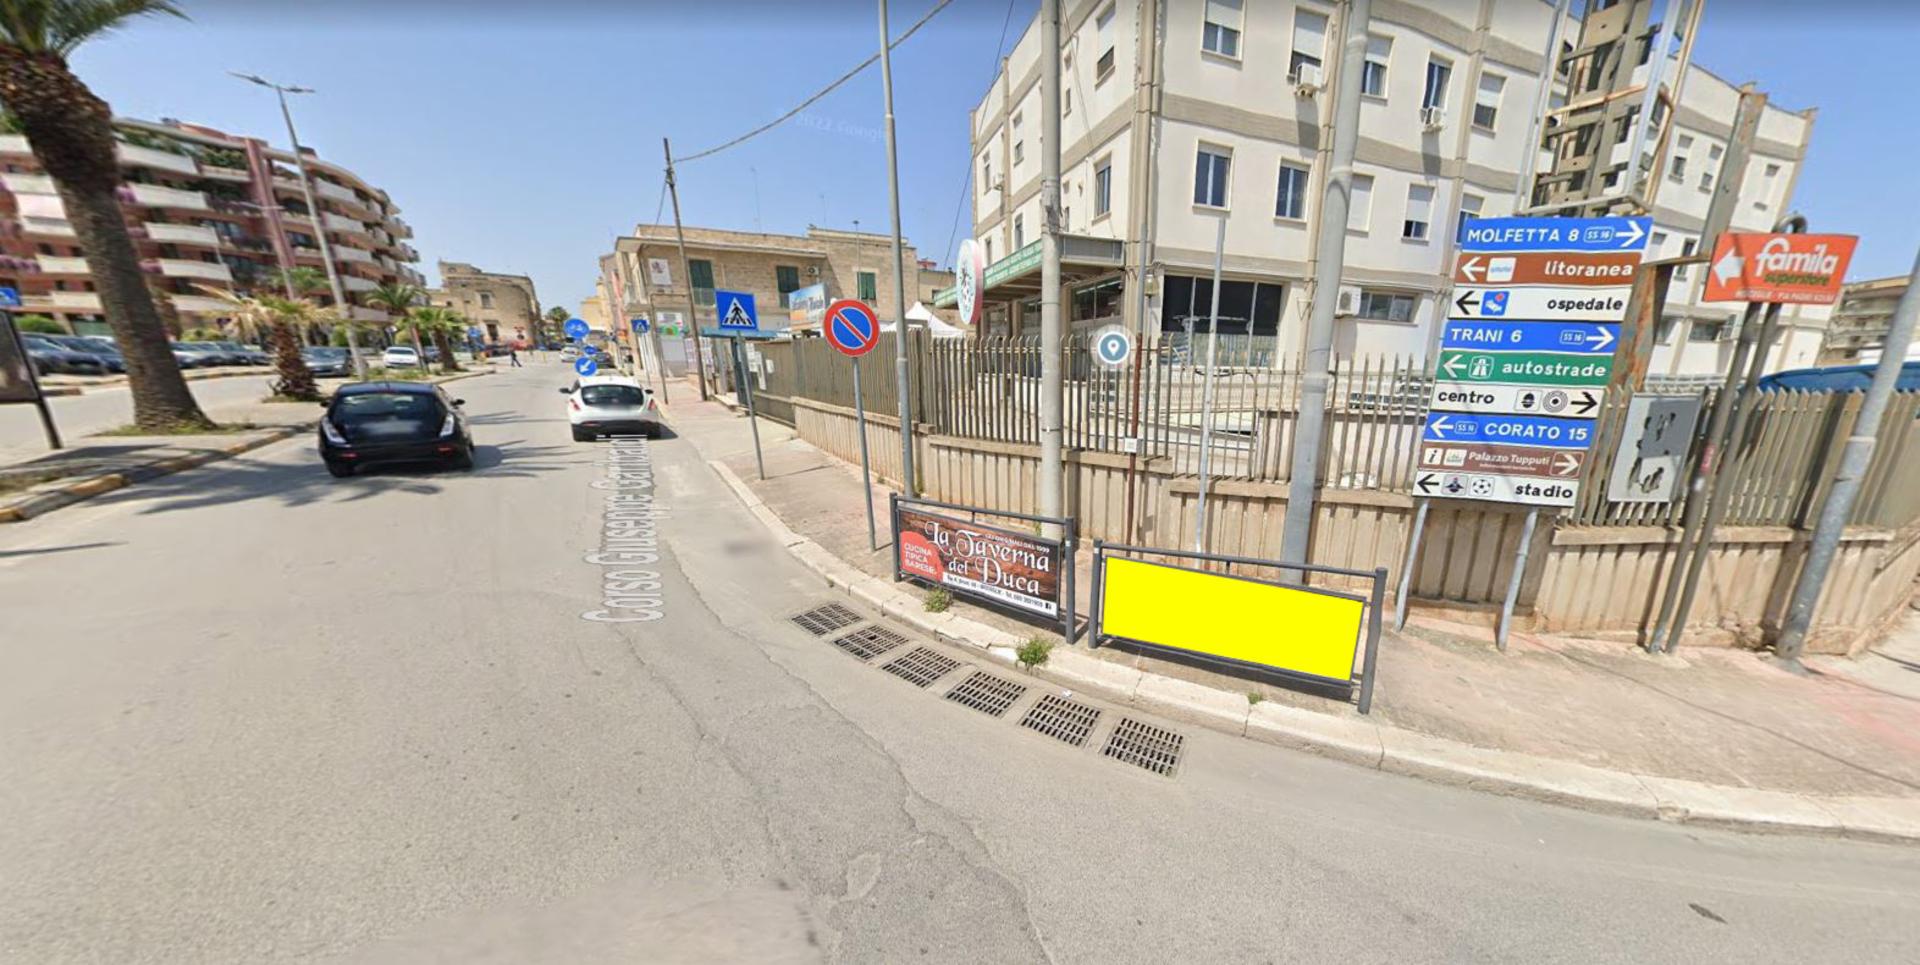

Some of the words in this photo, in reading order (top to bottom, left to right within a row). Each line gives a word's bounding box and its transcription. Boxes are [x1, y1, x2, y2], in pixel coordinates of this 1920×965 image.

[1467, 228, 1560, 242] MOLFETTA
[1568, 228, 1580, 242] 8
[1754, 237, 1840, 277] famila
[1544, 261, 1633, 276] litoranea
[1547, 297, 1623, 312] ospedale
[1451, 328, 1503, 342] TRANI
[1510, 329, 1522, 343] 6
[1502, 360, 1606, 377] autostrade
[1438, 390, 1494, 405] centro
[1484, 422, 1560, 439] CORATO
[1568, 427, 1588, 441] 15
[1468, 451, 1509, 463] Palazzo
[1511, 454, 1551, 466] Tupputi
[1515, 484, 1573, 499] stadio
[904, 543, 933, 557] CUCINA
[924, 520, 953, 557] La
[955, 529, 1050, 572] Taverna
[948, 559, 968, 576] del
[975, 557, 1040, 596] Duca
